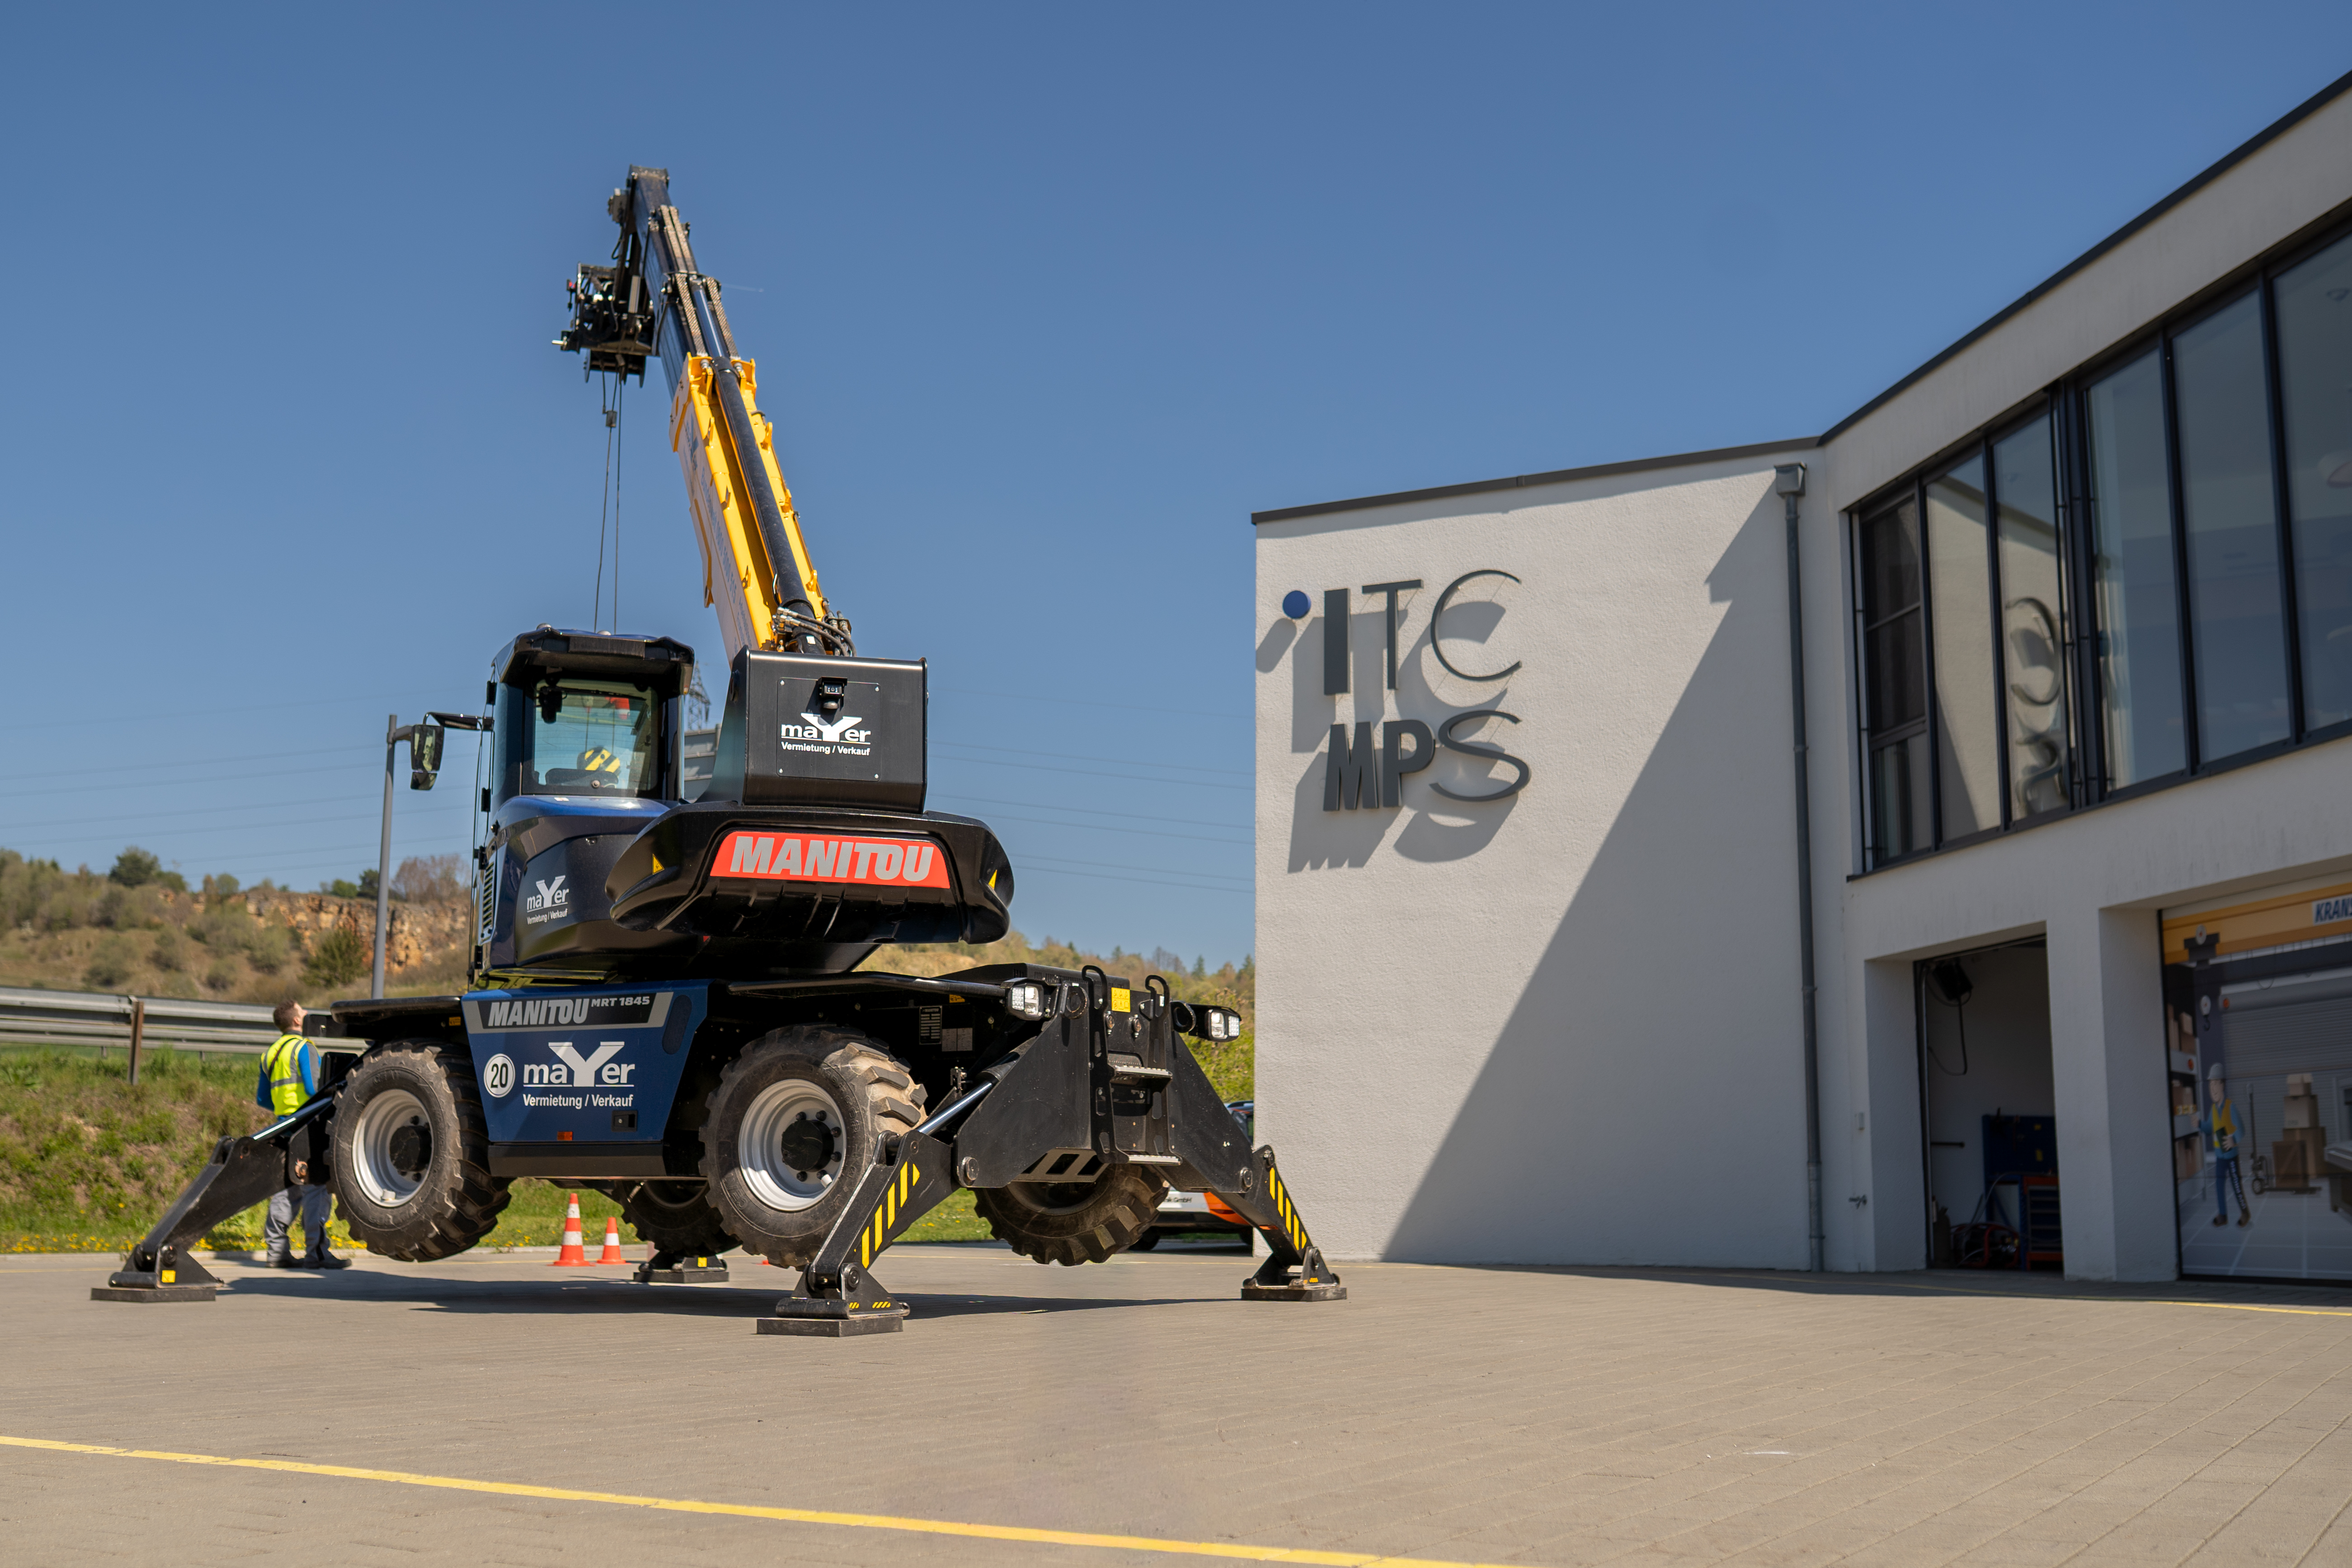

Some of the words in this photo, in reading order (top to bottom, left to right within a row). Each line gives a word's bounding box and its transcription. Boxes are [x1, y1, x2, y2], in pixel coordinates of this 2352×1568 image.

[1324, 570, 1522, 695] ITC
[781, 741, 830, 754] Vermietung
[837, 745, 870, 756] Verkauf
[1323, 710, 1531, 811] MPS
[729, 836, 934, 882] MANITOU
[527, 914, 547, 925] Vermietung
[550, 908, 568, 919] Verkauf
[2315, 898, 2352, 923] KRAN
[488, 998, 589, 1026] MANITOU
[591, 997, 617, 1007] MRT
[620, 996, 650, 1006] 1845
[491, 1063, 508, 1088] 20
[523, 1094, 582, 1109] Vermietung
[584, 1094, 588, 1107] /
[592, 1094, 634, 1107] Verkauf
